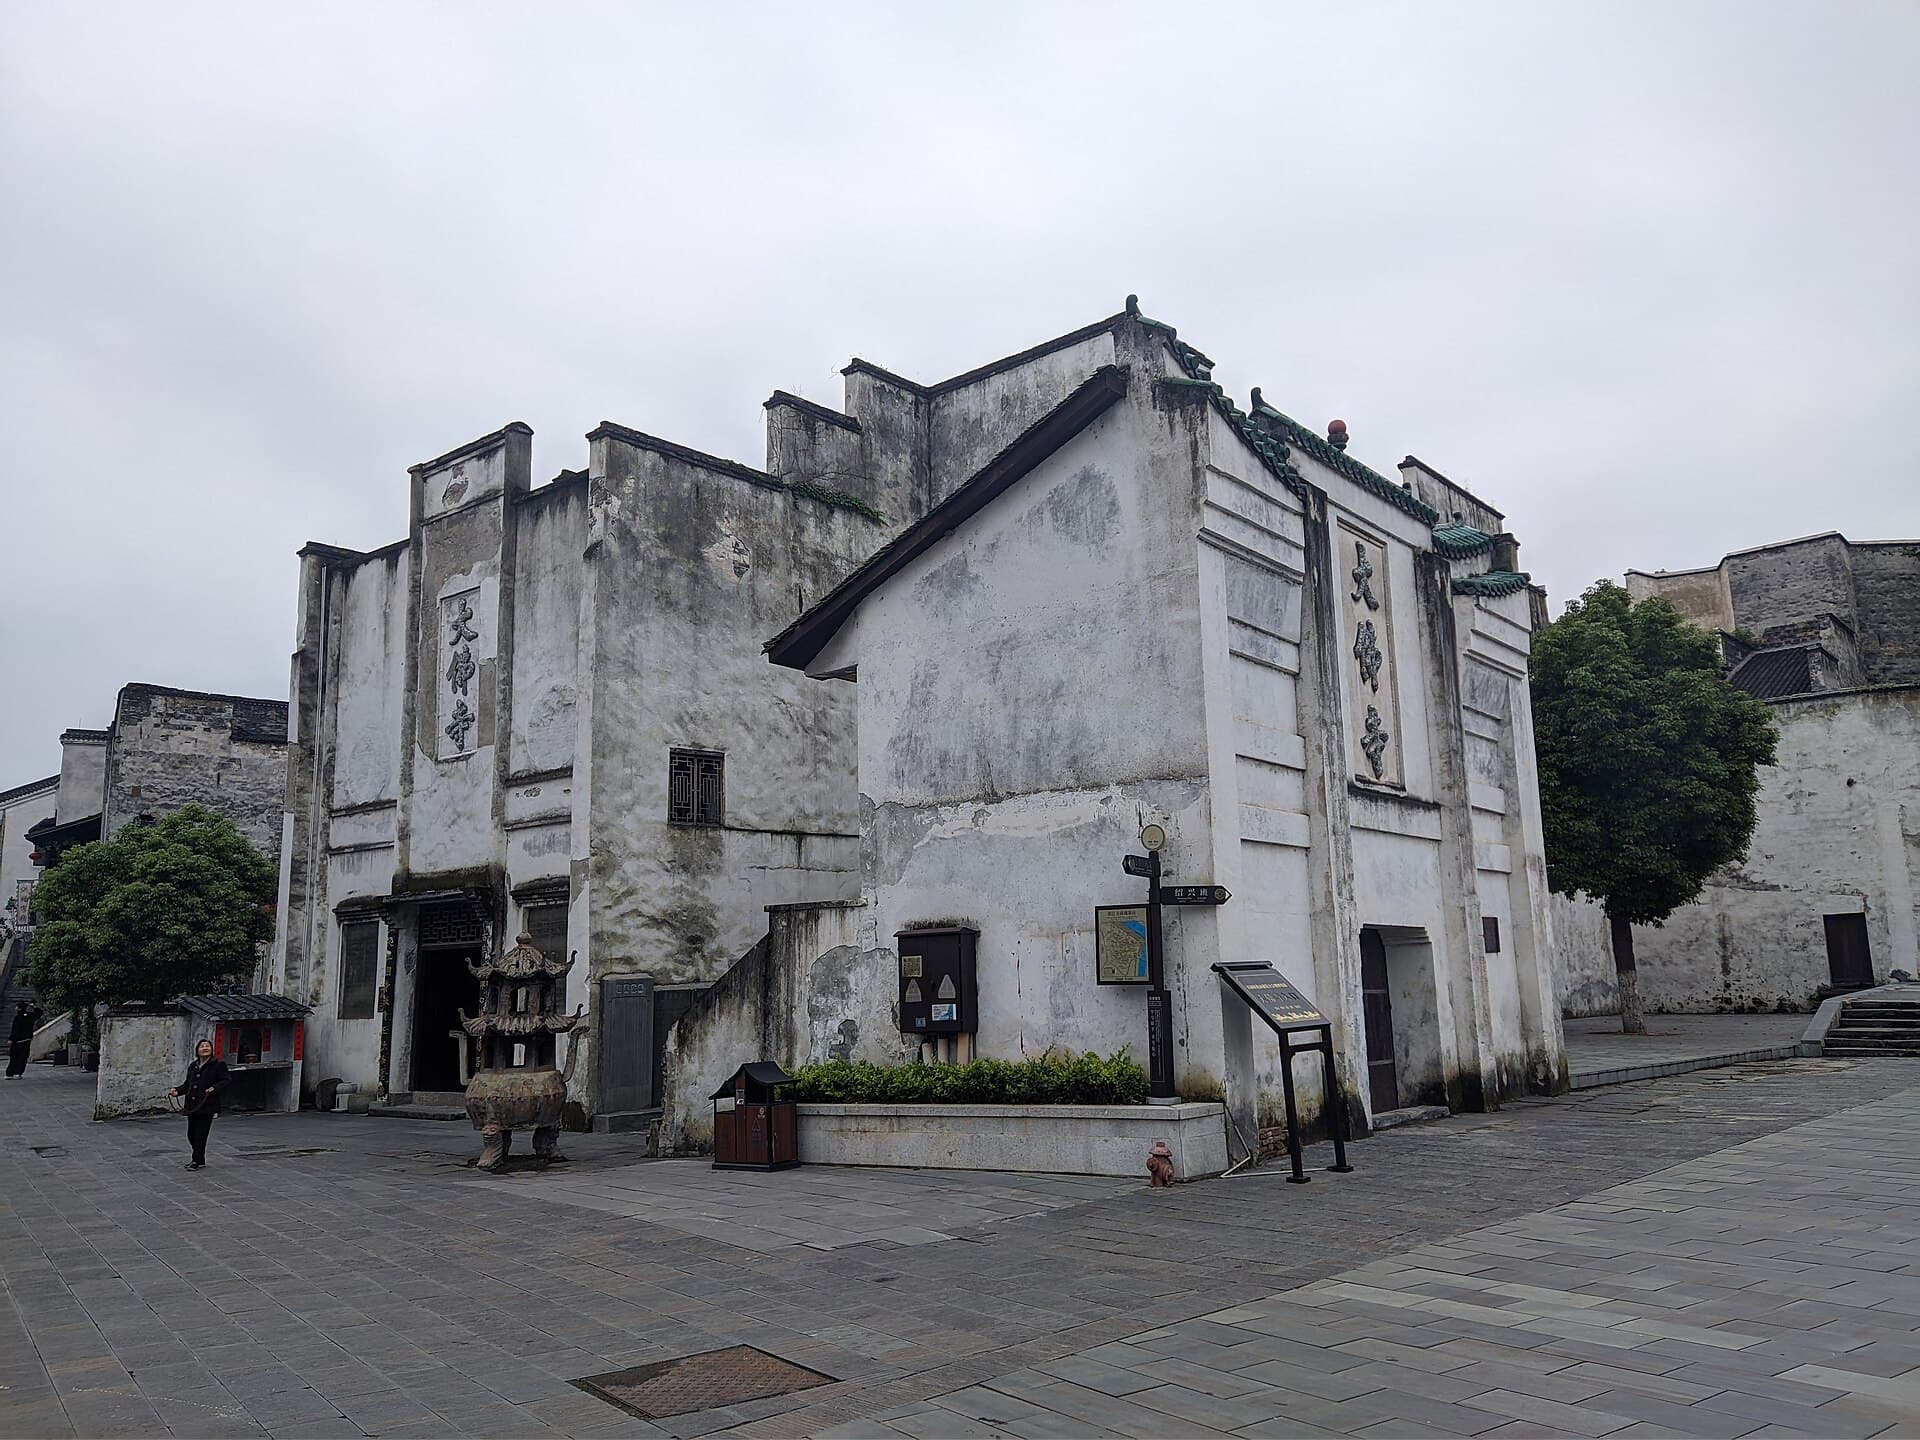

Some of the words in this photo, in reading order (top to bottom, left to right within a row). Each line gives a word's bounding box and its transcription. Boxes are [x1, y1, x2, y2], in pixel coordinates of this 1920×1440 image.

[445, 599, 478, 752] 大佛寺
[1351, 541, 1389, 779] 大佛寺
